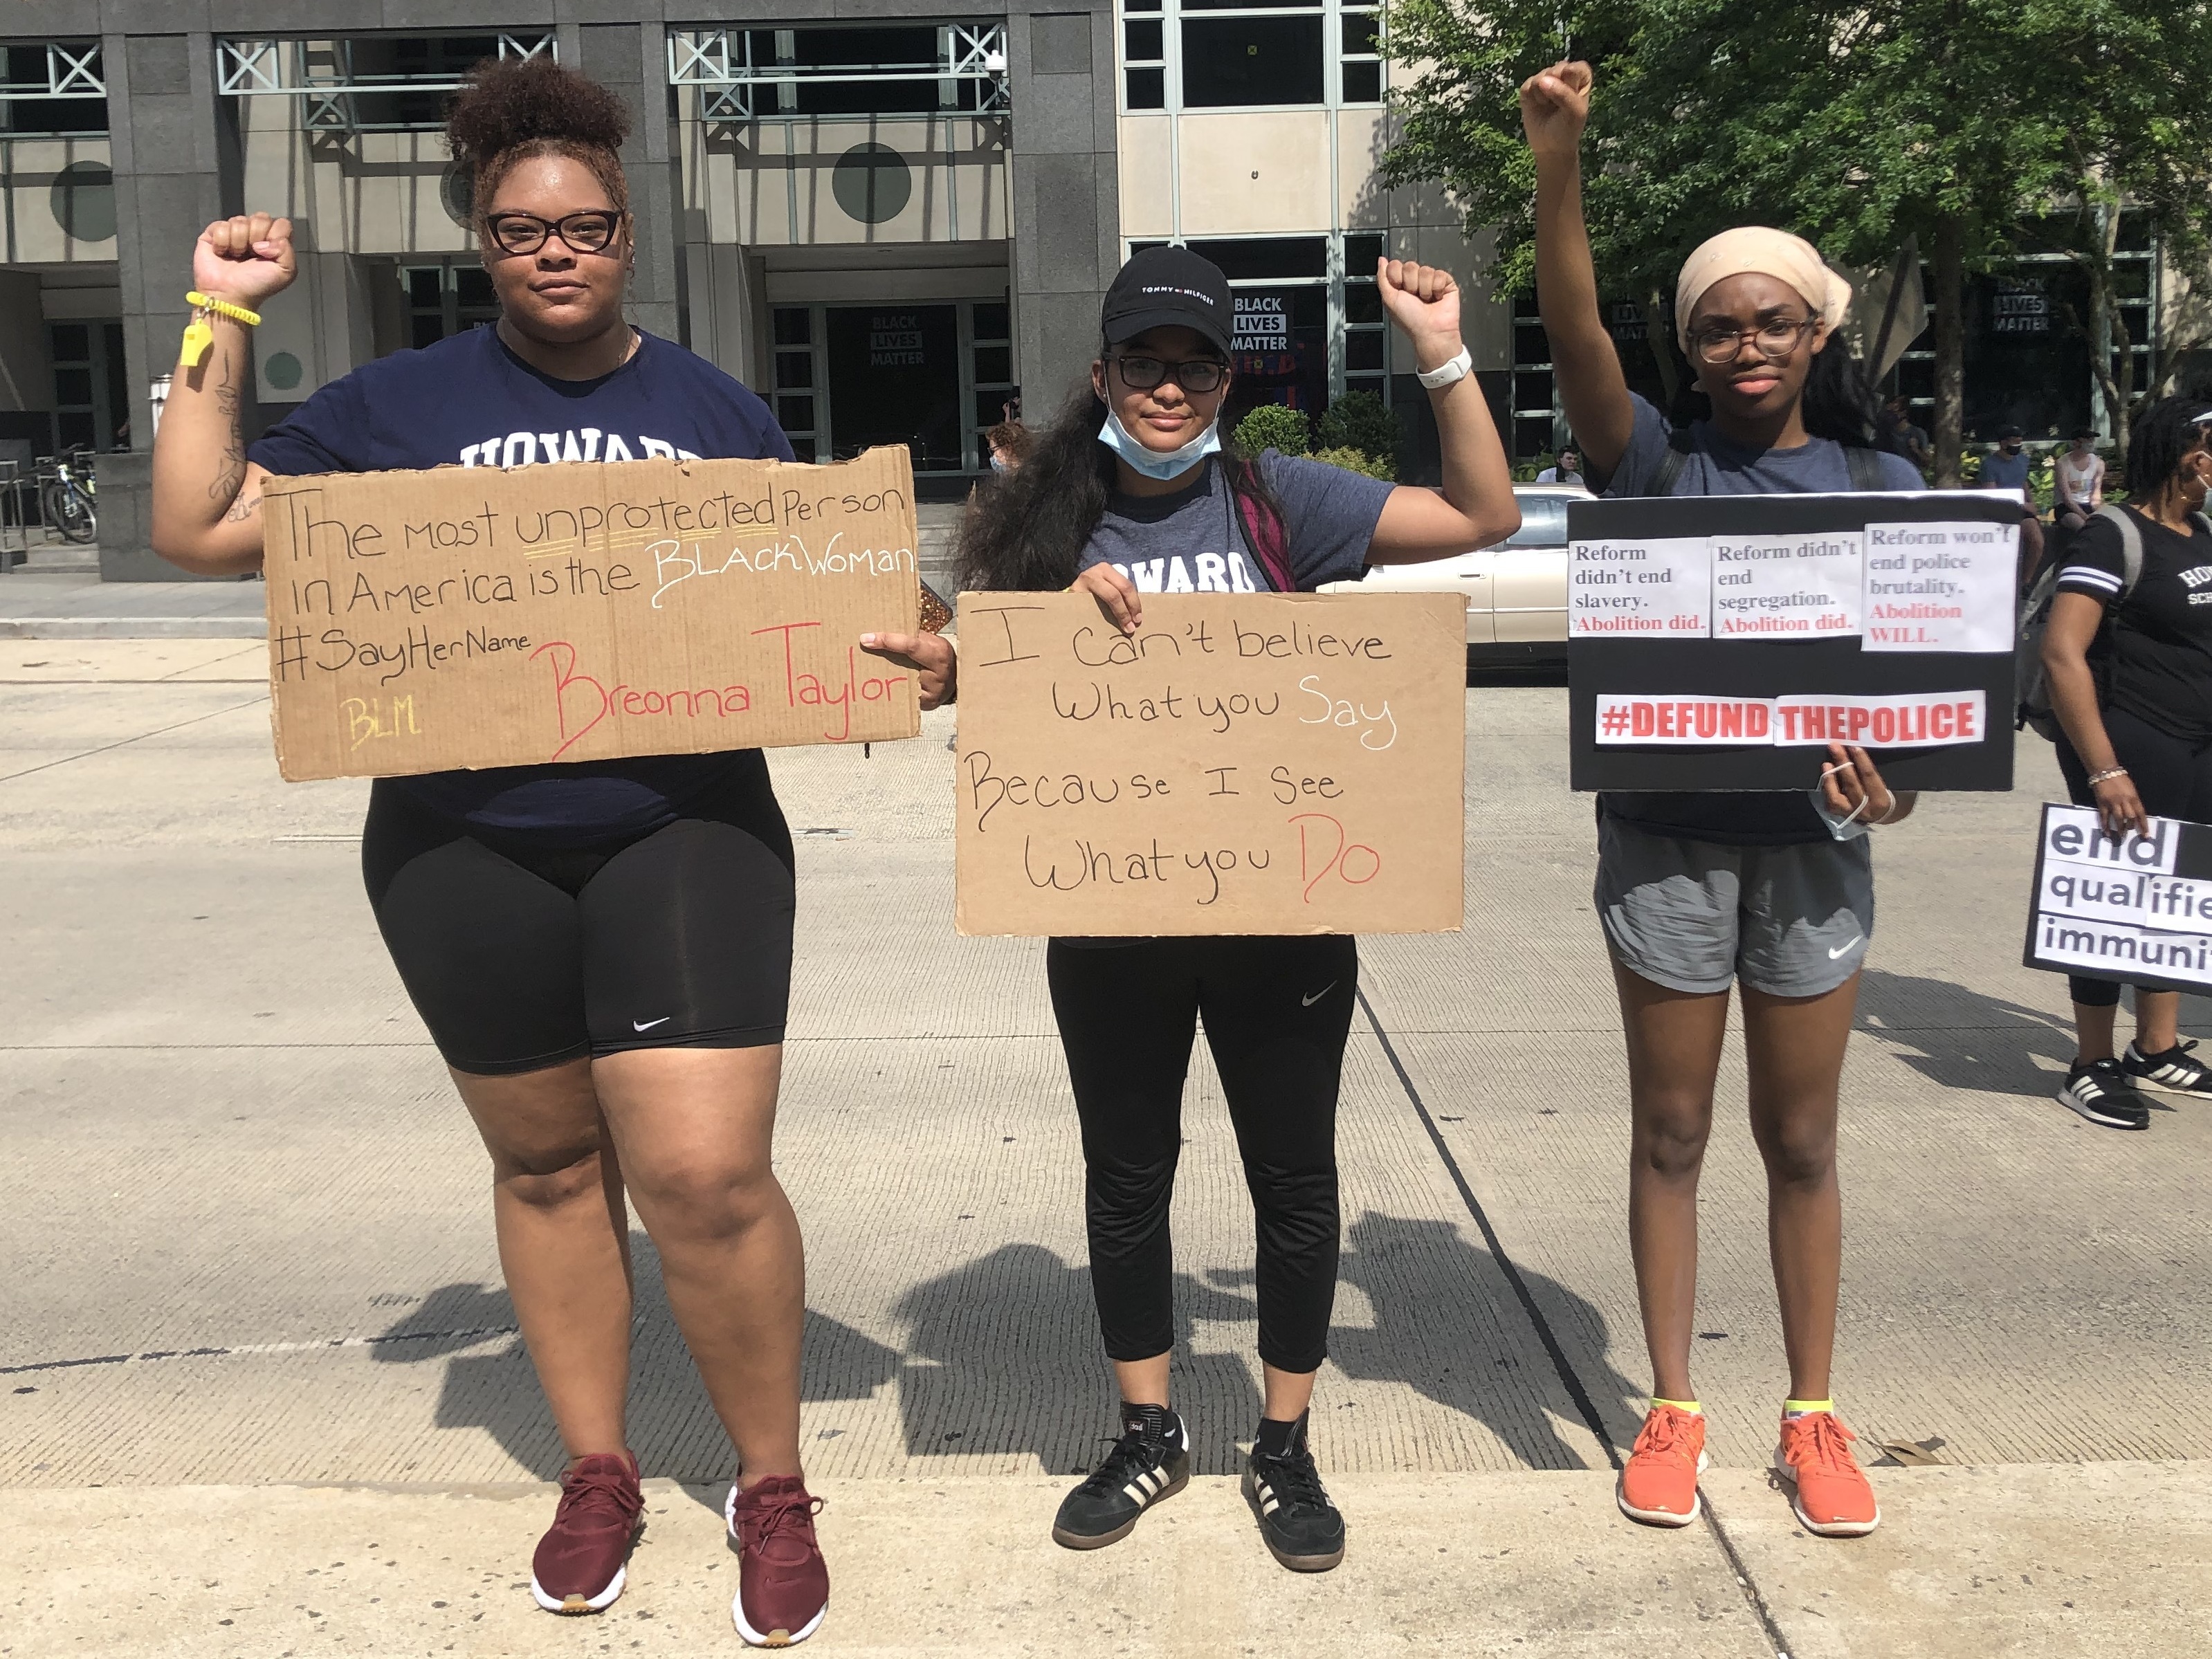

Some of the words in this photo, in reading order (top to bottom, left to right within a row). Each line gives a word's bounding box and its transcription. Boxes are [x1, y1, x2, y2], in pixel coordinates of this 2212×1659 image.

[1183, 288, 1214, 306] HILFIGER
[1234, 297, 1282, 312] BLACK
[873, 316, 917, 329] BLACK
[1236, 317, 1280, 331] LIVES
[875, 333, 917, 347] LIVES
[1230, 336, 1288, 351] MATTER
[871, 351, 925, 365] MATTER
[264, 488, 386, 561] The
[515, 481, 775, 547] unprotected
[1871, 529, 1947, 545] Reform
[1953, 524, 2011, 544] won't
[1575, 544, 1647, 561] Reform
[1717, 544, 1791, 562] Reform
[1797, 540, 1857, 558] didn't
[1869, 554, 1907, 570] end
[1912, 553, 1972, 574] police
[528, 564, 558, 596] is
[564, 556, 641, 596] the
[1575, 568, 1633, 585] didn't
[1638, 568, 1672, 584] end
[1717, 569, 1753, 586] end
[1870, 578, 1966, 598] brutality.
[1575, 593, 1649, 612] slavery.
[1719, 590, 1836, 613] segregation.
[1870, 603, 1963, 619] Abolition
[1575, 615, 1663, 632] Abolition
[1668, 614, 1706, 630] did.
[1720, 616, 1810, 634] Abolition
[1815, 613, 1855, 630] did.
[970, 607, 1045, 666] I
[1233, 619, 1392, 659] believe
[1870, 627, 1939, 643] WILL.
[274, 624, 532, 687] #SayHerName
[529, 641, 751, 762] Breonna
[751, 622, 908, 741] Taylor
[1197, 692, 1280, 733] you
[1298, 674, 1398, 751] Say
[1601, 702, 1769, 740] #DEFUND
[339, 695, 422, 752] BLM
[964, 751, 1171, 833] Because
[1204, 767, 1239, 797] I
[2051, 821, 2167, 868] end
[1185, 847, 1271, 906] you
[1288, 813, 1381, 904] Do
[2044, 917, 2212, 971] immuni
